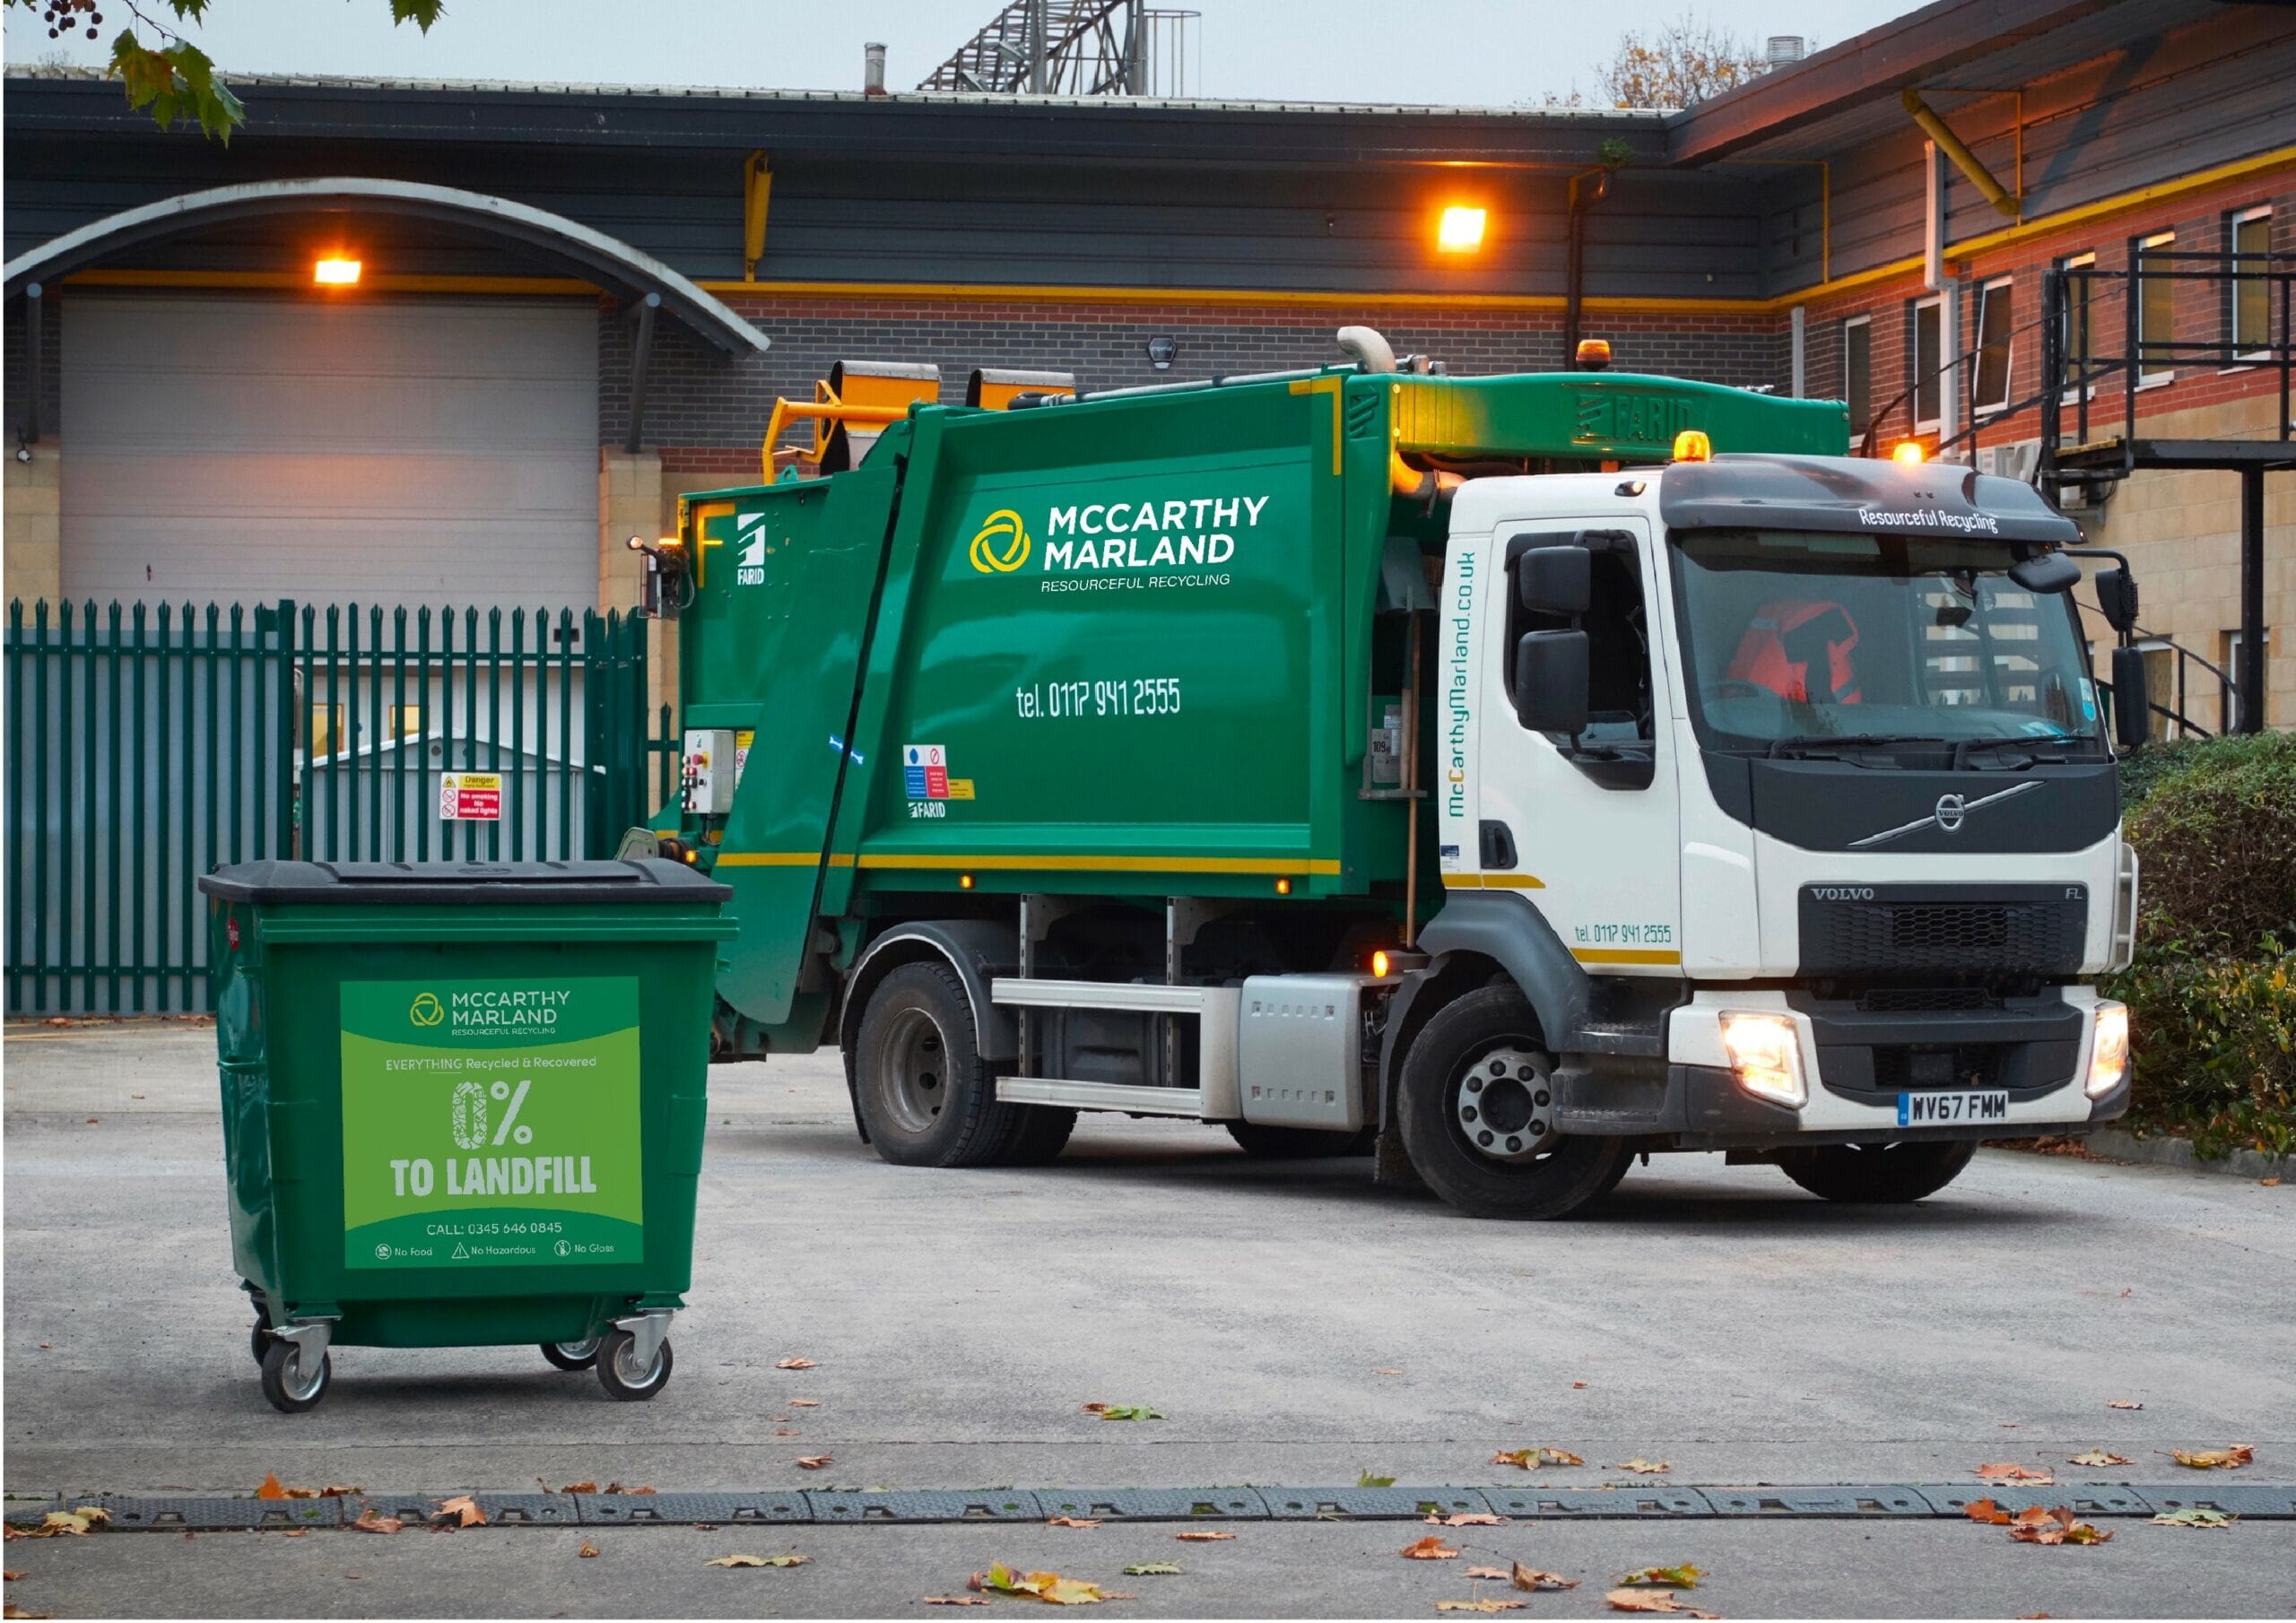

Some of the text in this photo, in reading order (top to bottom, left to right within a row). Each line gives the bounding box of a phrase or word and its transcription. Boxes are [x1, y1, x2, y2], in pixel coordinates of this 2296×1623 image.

[1048, 496, 1270, 536] MCCARTHY
[1858, 508, 1999, 534] Resourceful Recycling
[1043, 534, 1235, 571] MARLAND
[737, 568, 765, 586] FARID
[1041, 573, 1231, 593] RESOURCEFUL RECYCLING
[1448, 551, 1475, 817] McCarthyMarland.co.uk
[1016, 678, 1180, 717] tel. 0117 941 2555
[465, 776, 495, 785] Danger
[471, 794, 498, 802] smoking
[480, 807, 498, 816] lights
[918, 802, 946, 818] FARID
[1810, 888, 1874, 900] VOLVO
[2066, 888, 2083, 899] FL
[1575, 924, 1672, 942] tel. 0117 941 2555
[452, 991, 570, 1007] MCCARTHY
[452, 1009, 557, 1025] MARLAND
[451, 1027, 556, 1036] RESOURCEFUL RECYCLING
[386, 1056, 596, 1071] EVERYTHING Recycled & Recovered
[452, 1080, 533, 1150] 0%
[1913, 1094, 2005, 1120] WV67 FMM
[390, 1156, 597, 1197] TO LANDFILL
[426, 1222, 562, 1235] CALL: 0345 646 0845
[395, 1247, 433, 1256] No Food
[471, 1245, 535, 1254] No Hazardous
[574, 1244, 614, 1253] No Glass
